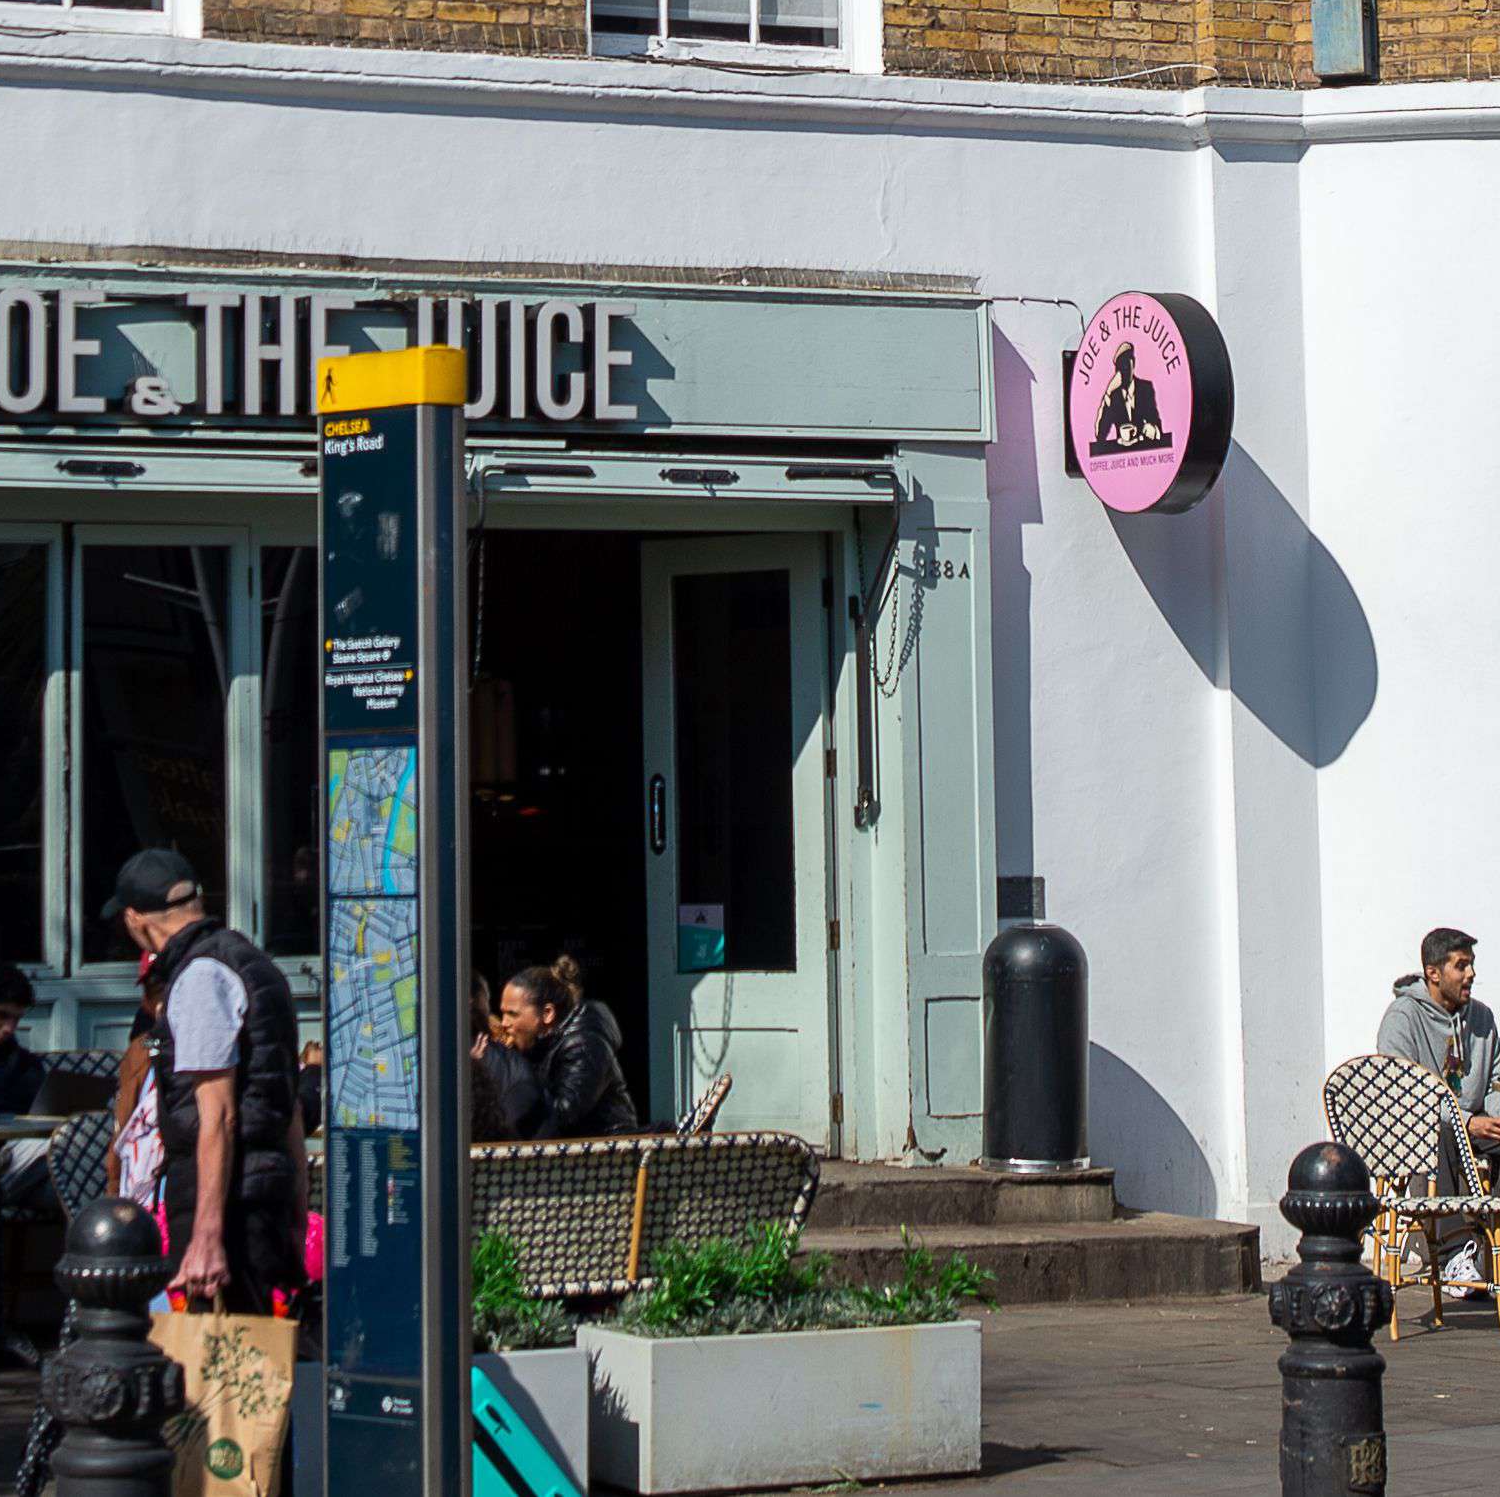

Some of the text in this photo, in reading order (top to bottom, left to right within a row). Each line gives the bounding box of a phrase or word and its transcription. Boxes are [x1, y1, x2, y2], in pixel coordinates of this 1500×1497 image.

[1078, 305, 1181, 385] JOE & THE JUICE
[131, 375, 181, 416] &
[324, 417, 371, 437] CHELSEA
[324, 433, 384, 457] King's Road
[1127, 456, 1139, 467] AND
